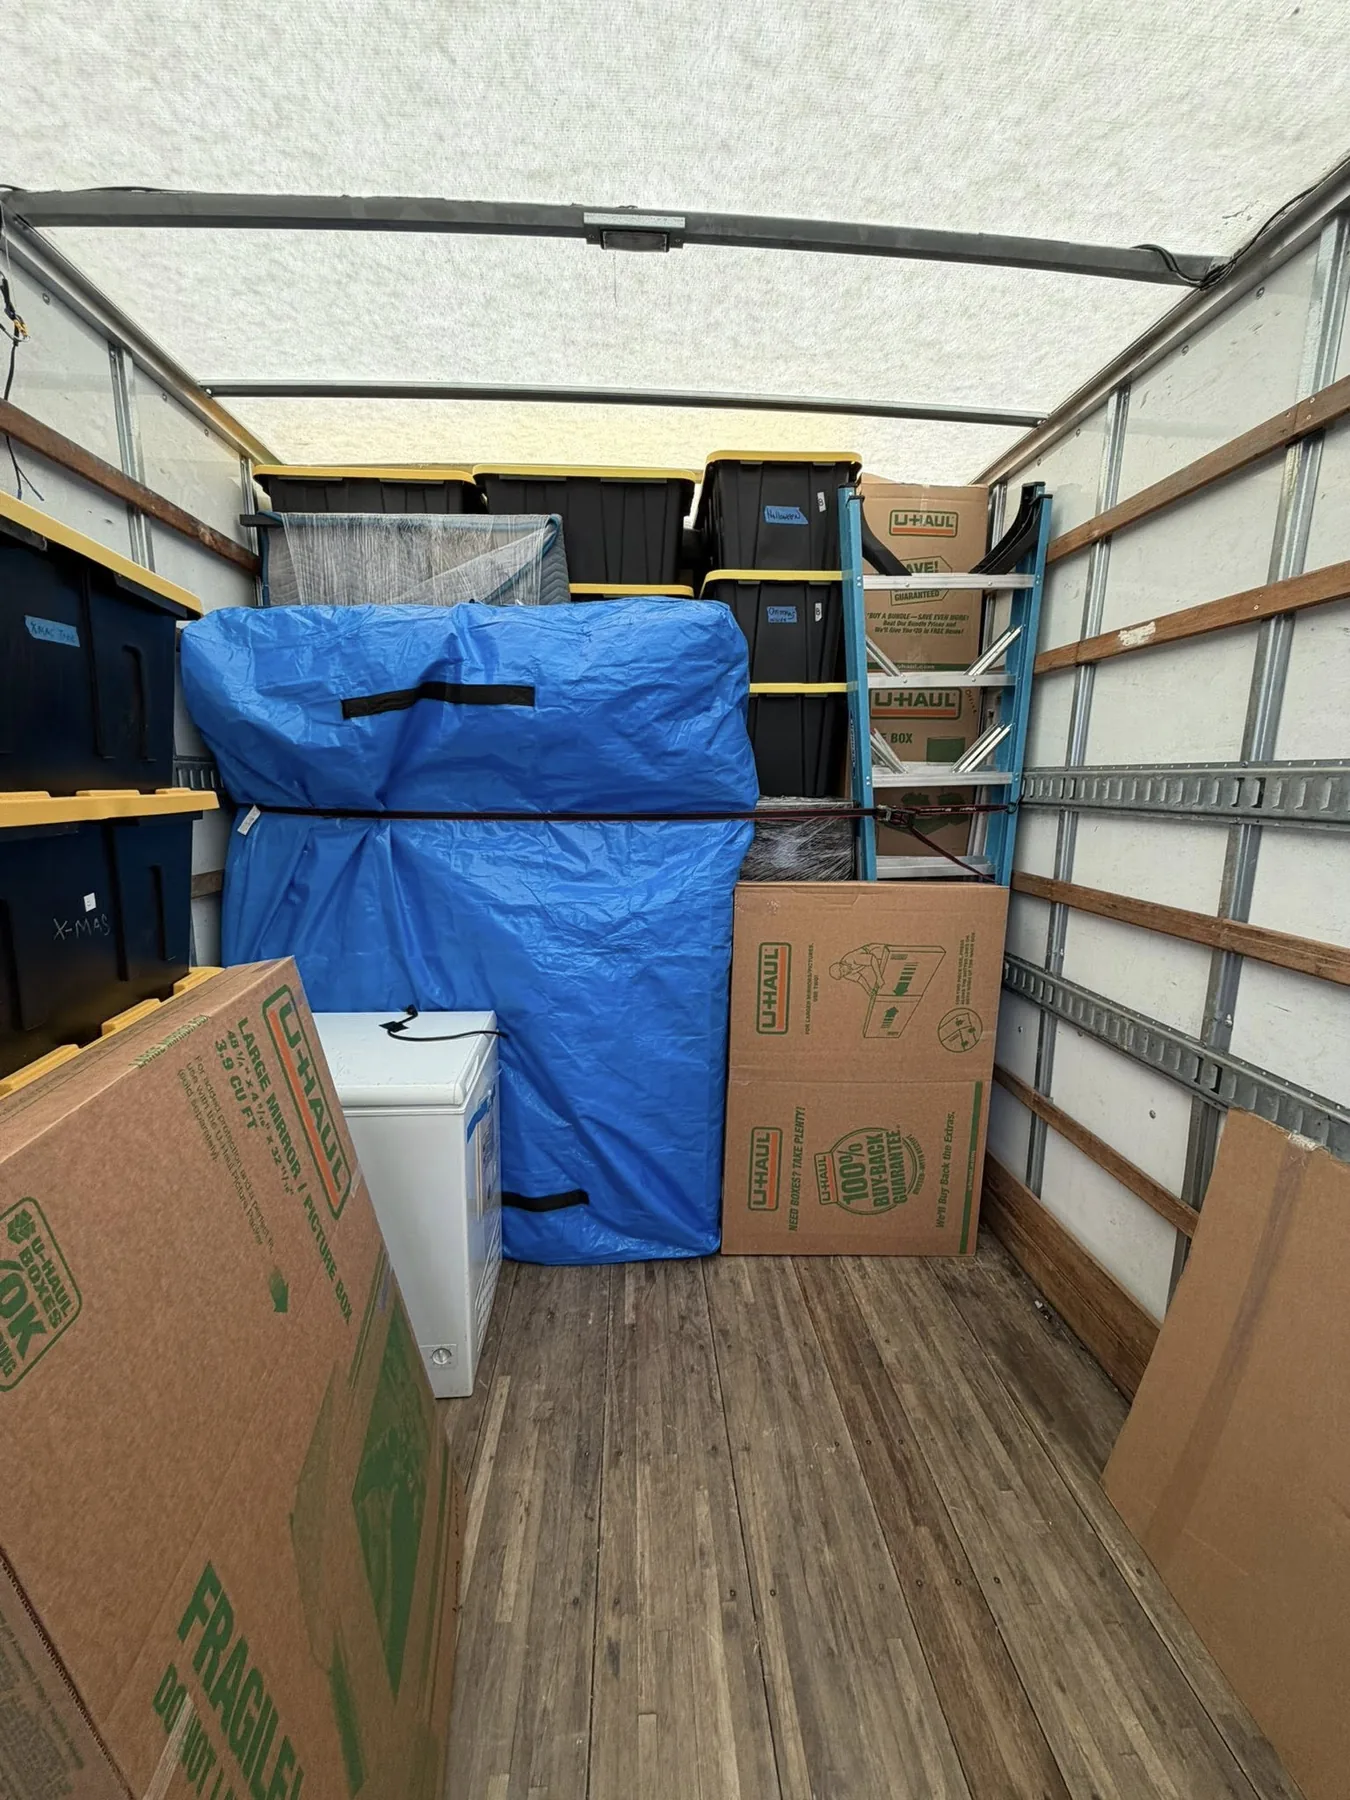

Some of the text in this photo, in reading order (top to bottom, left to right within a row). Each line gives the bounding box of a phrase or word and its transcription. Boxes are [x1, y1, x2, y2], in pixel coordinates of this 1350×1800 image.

[894, 514, 954, 528] U-HAUL
[894, 590, 940, 601] GUARANTEED
[905, 561, 939, 573] AVE!
[874, 692, 956, 707] U-HAUL
[891, 732, 913, 744] BOX
[53, 913, 111, 941] X-MAS
[762, 948, 779, 1028] U-HAUL
[177, 1069, 194, 1098] (sold
[186, 1062, 199, 1084] use
[196, 1084, 211, 1110] with
[206, 1110, 218, 1130] the
[215, 1130, 235, 1171] U-Haul
[194, 1055, 205, 1075] For
[203, 1077, 222, 1114] added
[214, 1039, 259, 1129] 3.9 CU FT
[228, 1030, 240, 1049] 48
[251, 1092, 259, 1102] 4
[271, 1146, 282, 1166] 32
[280, 1001, 343, 1192] U-HAUL
[238, 1017, 271, 1093] LARGE
[266, 1092, 300, 1181] MIRROR
[304, 1192, 338, 1282] PICTURE
[335, 1278, 353, 1325] BOX
[753, 1132, 770, 1205] U-HAUL
[788, 1106, 806, 1231] NEED BOXES? TAKE PLENTY!
[818, 1156, 831, 1201] U-HAUL
[837, 1143, 869, 1205] 100%
[866, 1133, 890, 1207] BUY-BACK
[886, 1130, 908, 1204] GUARANTEE
[936, 1111, 956, 1228] We'll Buy Back the Extras.
[18, 1246, 62, 1330] BOXES
[31, 1235, 73, 1318] U-HAUL
[0, 1272, 47, 1360] OK
[153, 1662, 188, 1735] DO
